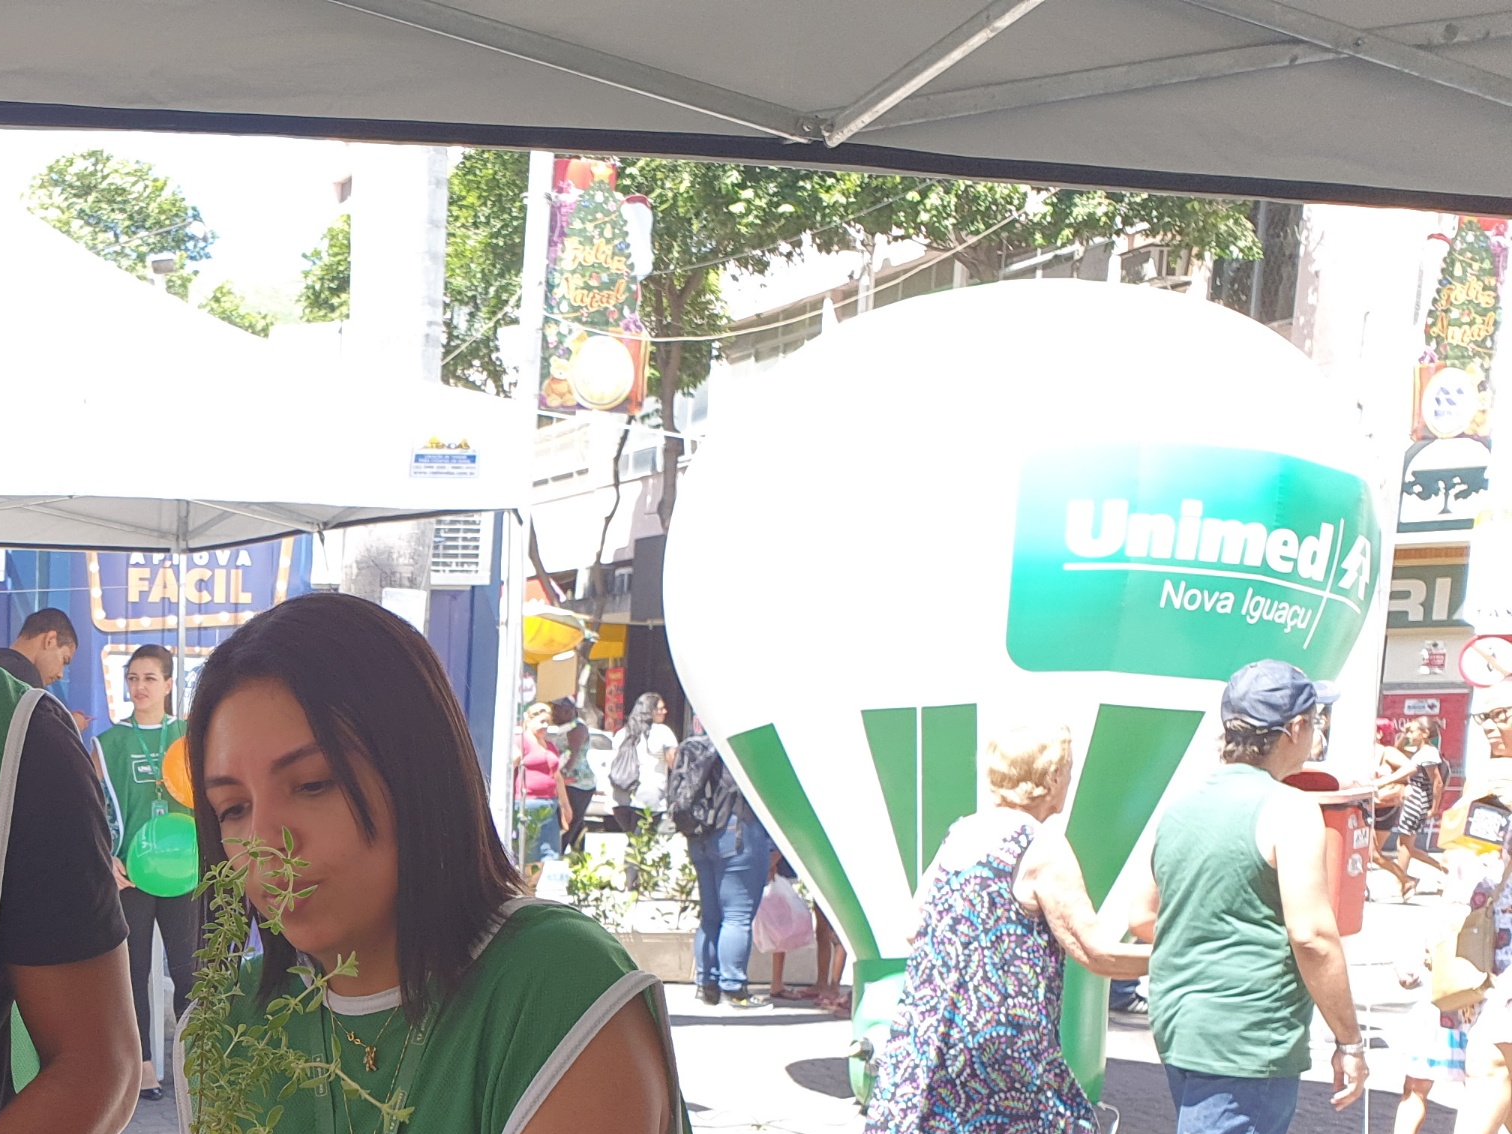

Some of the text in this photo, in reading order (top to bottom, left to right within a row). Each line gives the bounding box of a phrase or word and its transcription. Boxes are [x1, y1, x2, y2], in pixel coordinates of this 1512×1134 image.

[1064, 498, 1334, 582] Unimed
[127, 561, 252, 604] FÁCIL
[1159, 579, 1313, 634] Nova Iguaçu
[1389, 577, 1460, 622] RI
